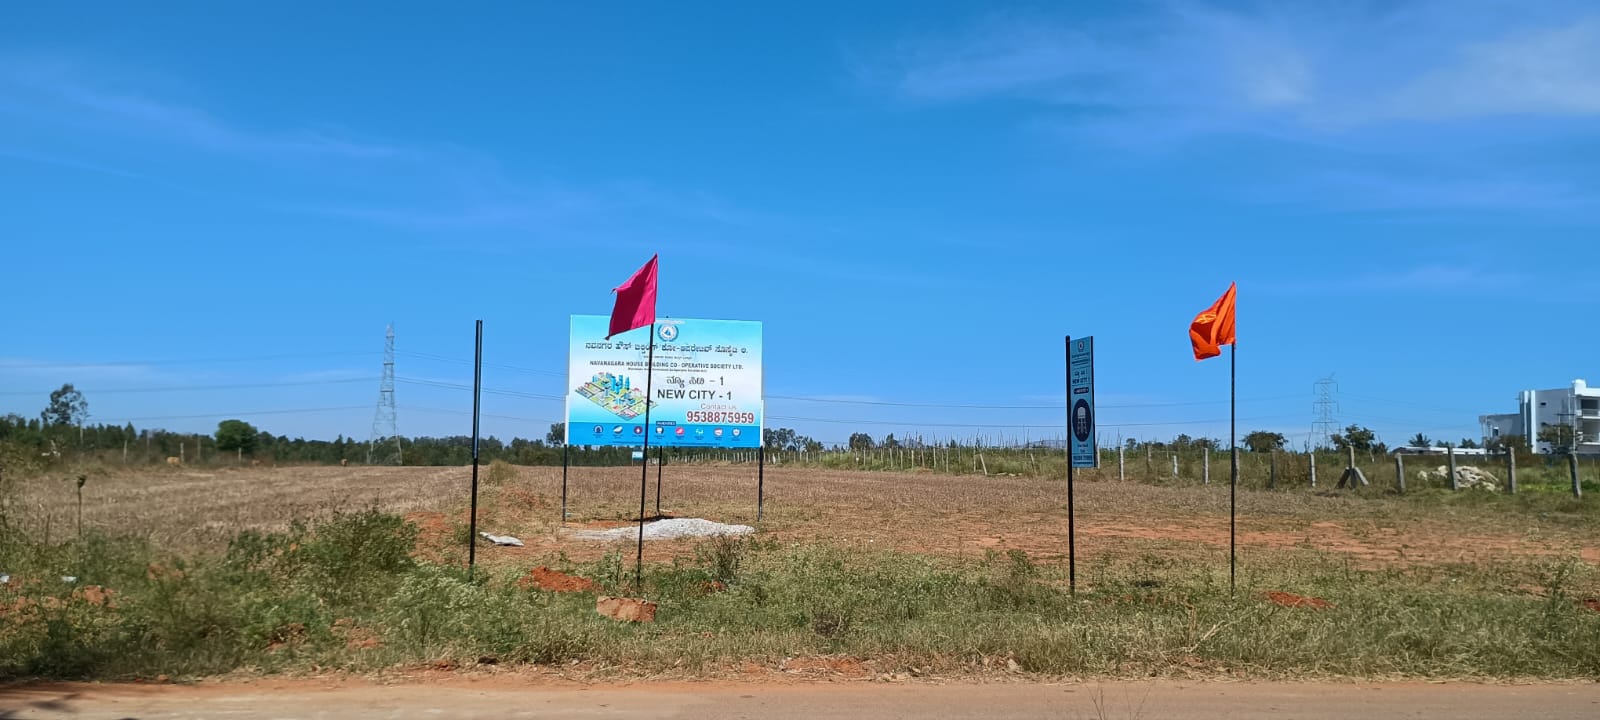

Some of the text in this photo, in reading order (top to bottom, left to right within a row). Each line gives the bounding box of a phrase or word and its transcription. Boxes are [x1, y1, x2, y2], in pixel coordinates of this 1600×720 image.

[719, 376, 724, 386] 1
[657, 389, 686, 399] NEW
[688, 389, 716, 400] CITY
[726, 391, 732, 401] 1
[686, 411, 754, 423] 9538875959
